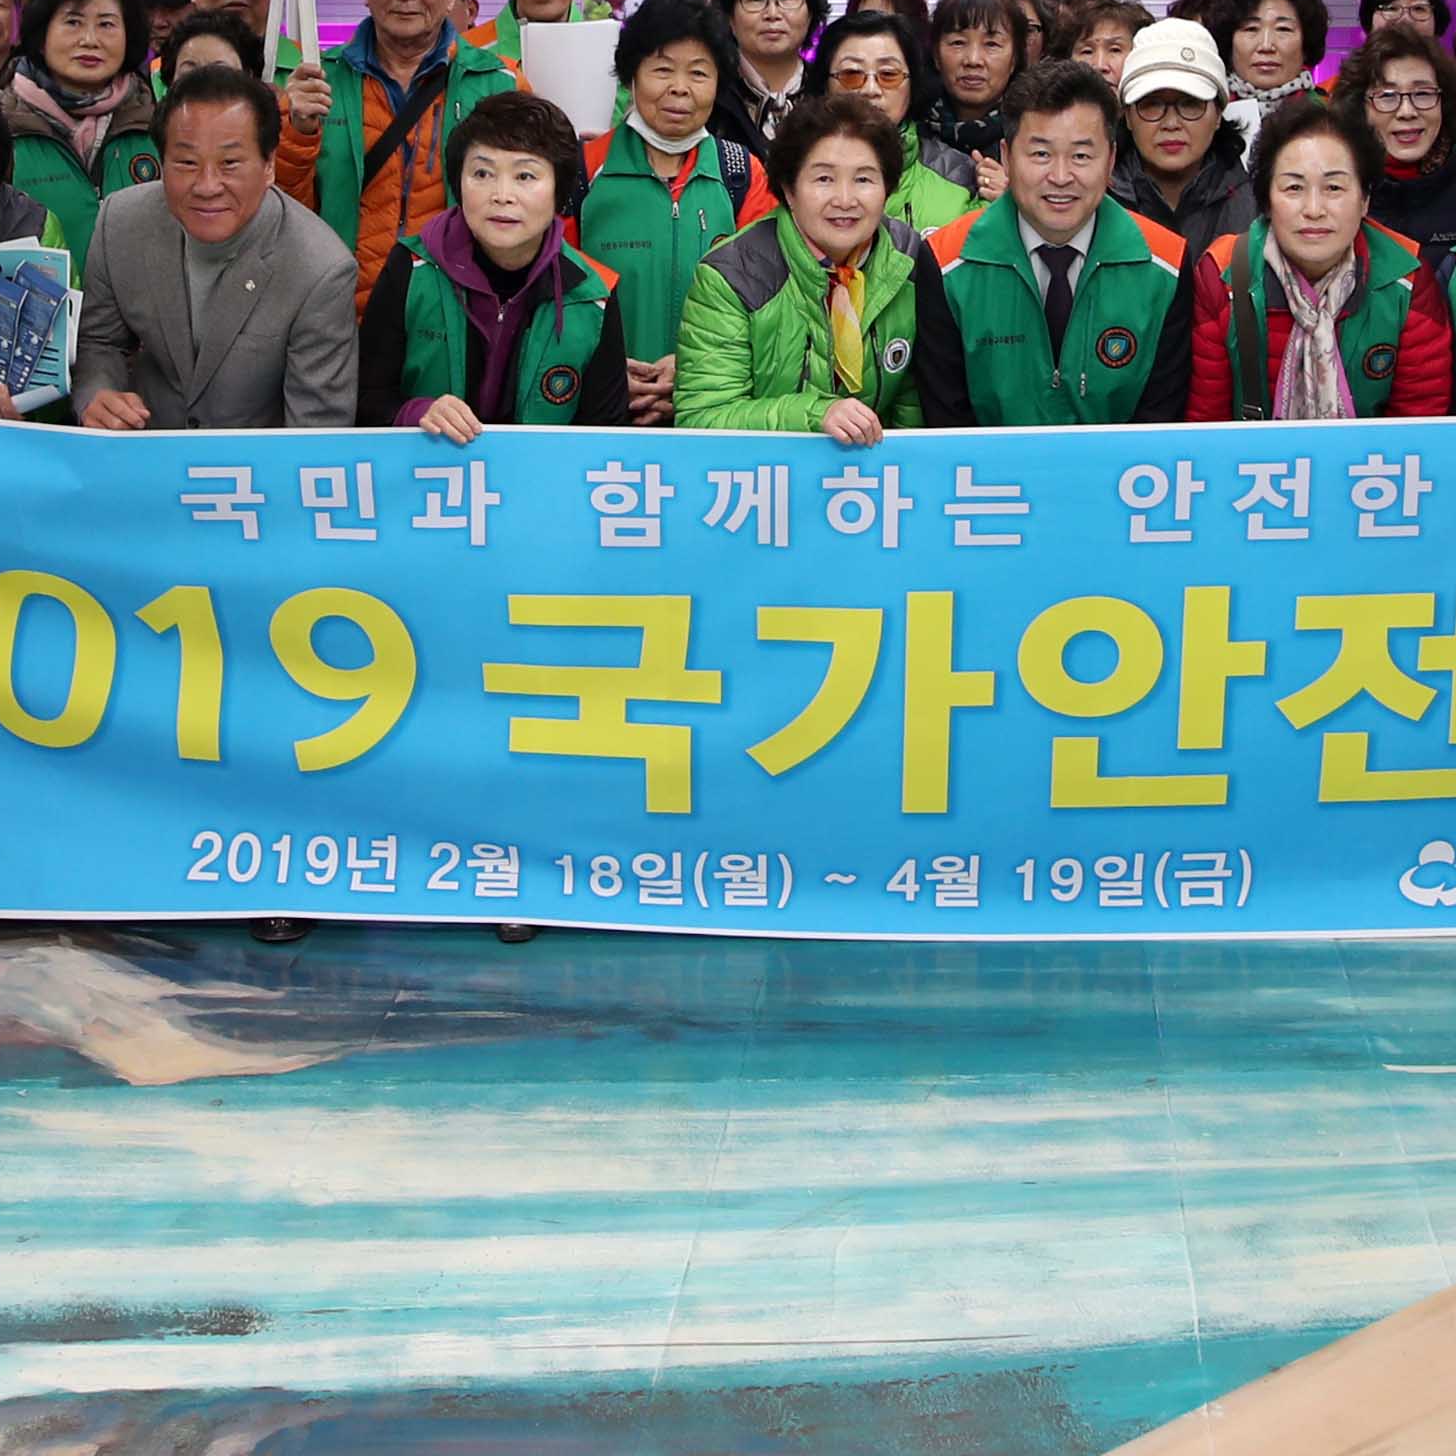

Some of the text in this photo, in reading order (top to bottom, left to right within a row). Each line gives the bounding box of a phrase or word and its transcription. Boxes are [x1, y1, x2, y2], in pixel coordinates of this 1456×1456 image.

[180, 460, 501, 547] 국민과
[585, 460, 1030, 549] 함께하는
[1117, 454, 1433, 543] 안전한
[187, 830, 398, 894] 2019년
[426, 841, 521, 899] 2월
[554, 851, 794, 909] 18일(월)
[885, 855, 979, 908] 4월
[1015, 849, 1253, 909] 19일(금)
